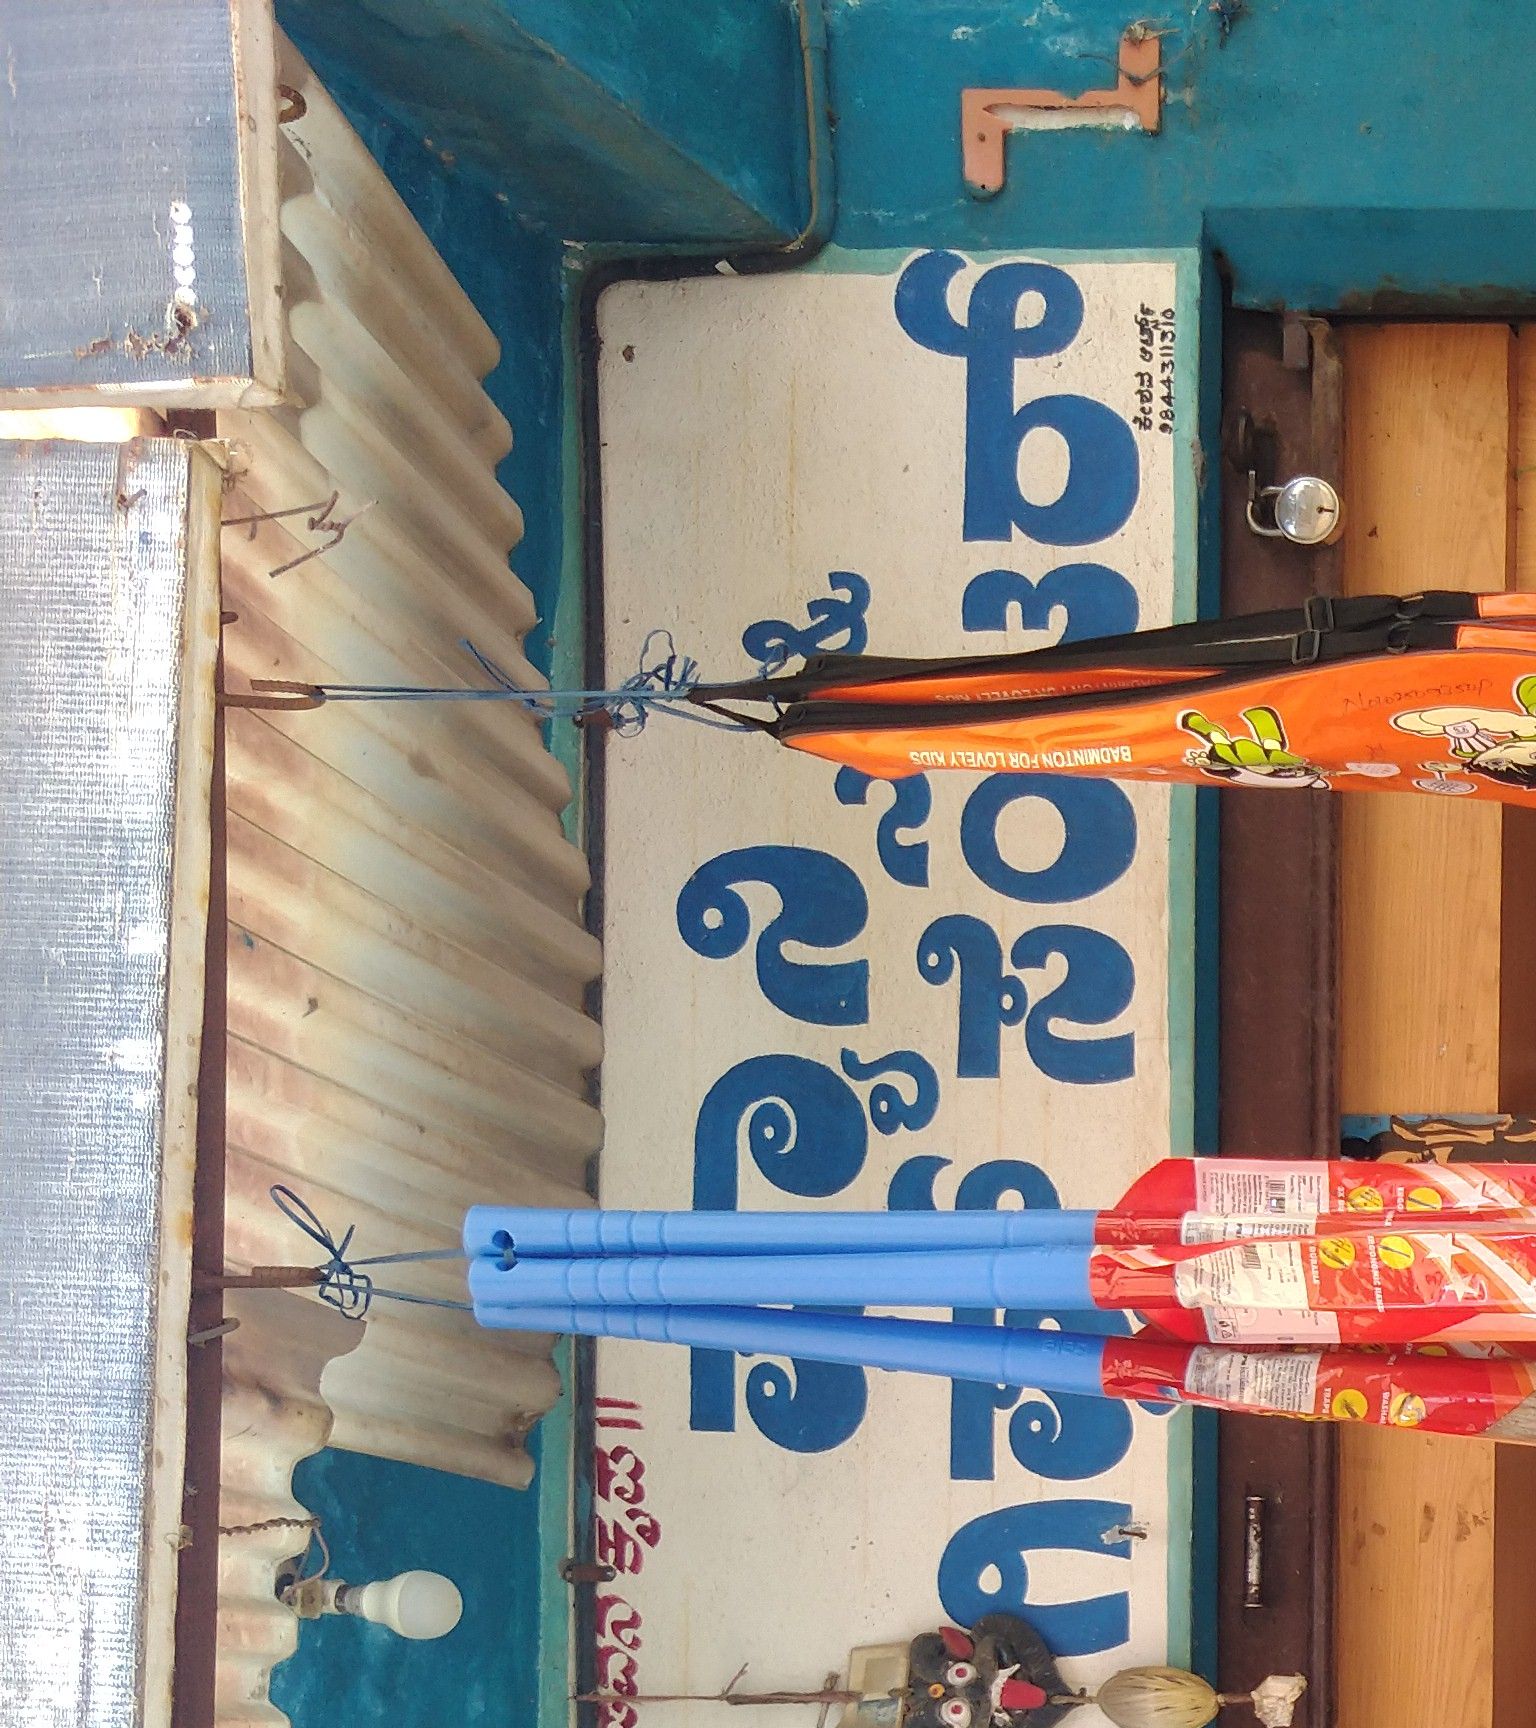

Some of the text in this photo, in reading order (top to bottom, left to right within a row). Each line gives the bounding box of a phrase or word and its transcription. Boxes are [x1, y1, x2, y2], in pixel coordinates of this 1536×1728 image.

[1158, 307, 1176, 435] 9844311310
[908, 745, 1133, 769] BADMINTON FOR LOVELY KIDS
